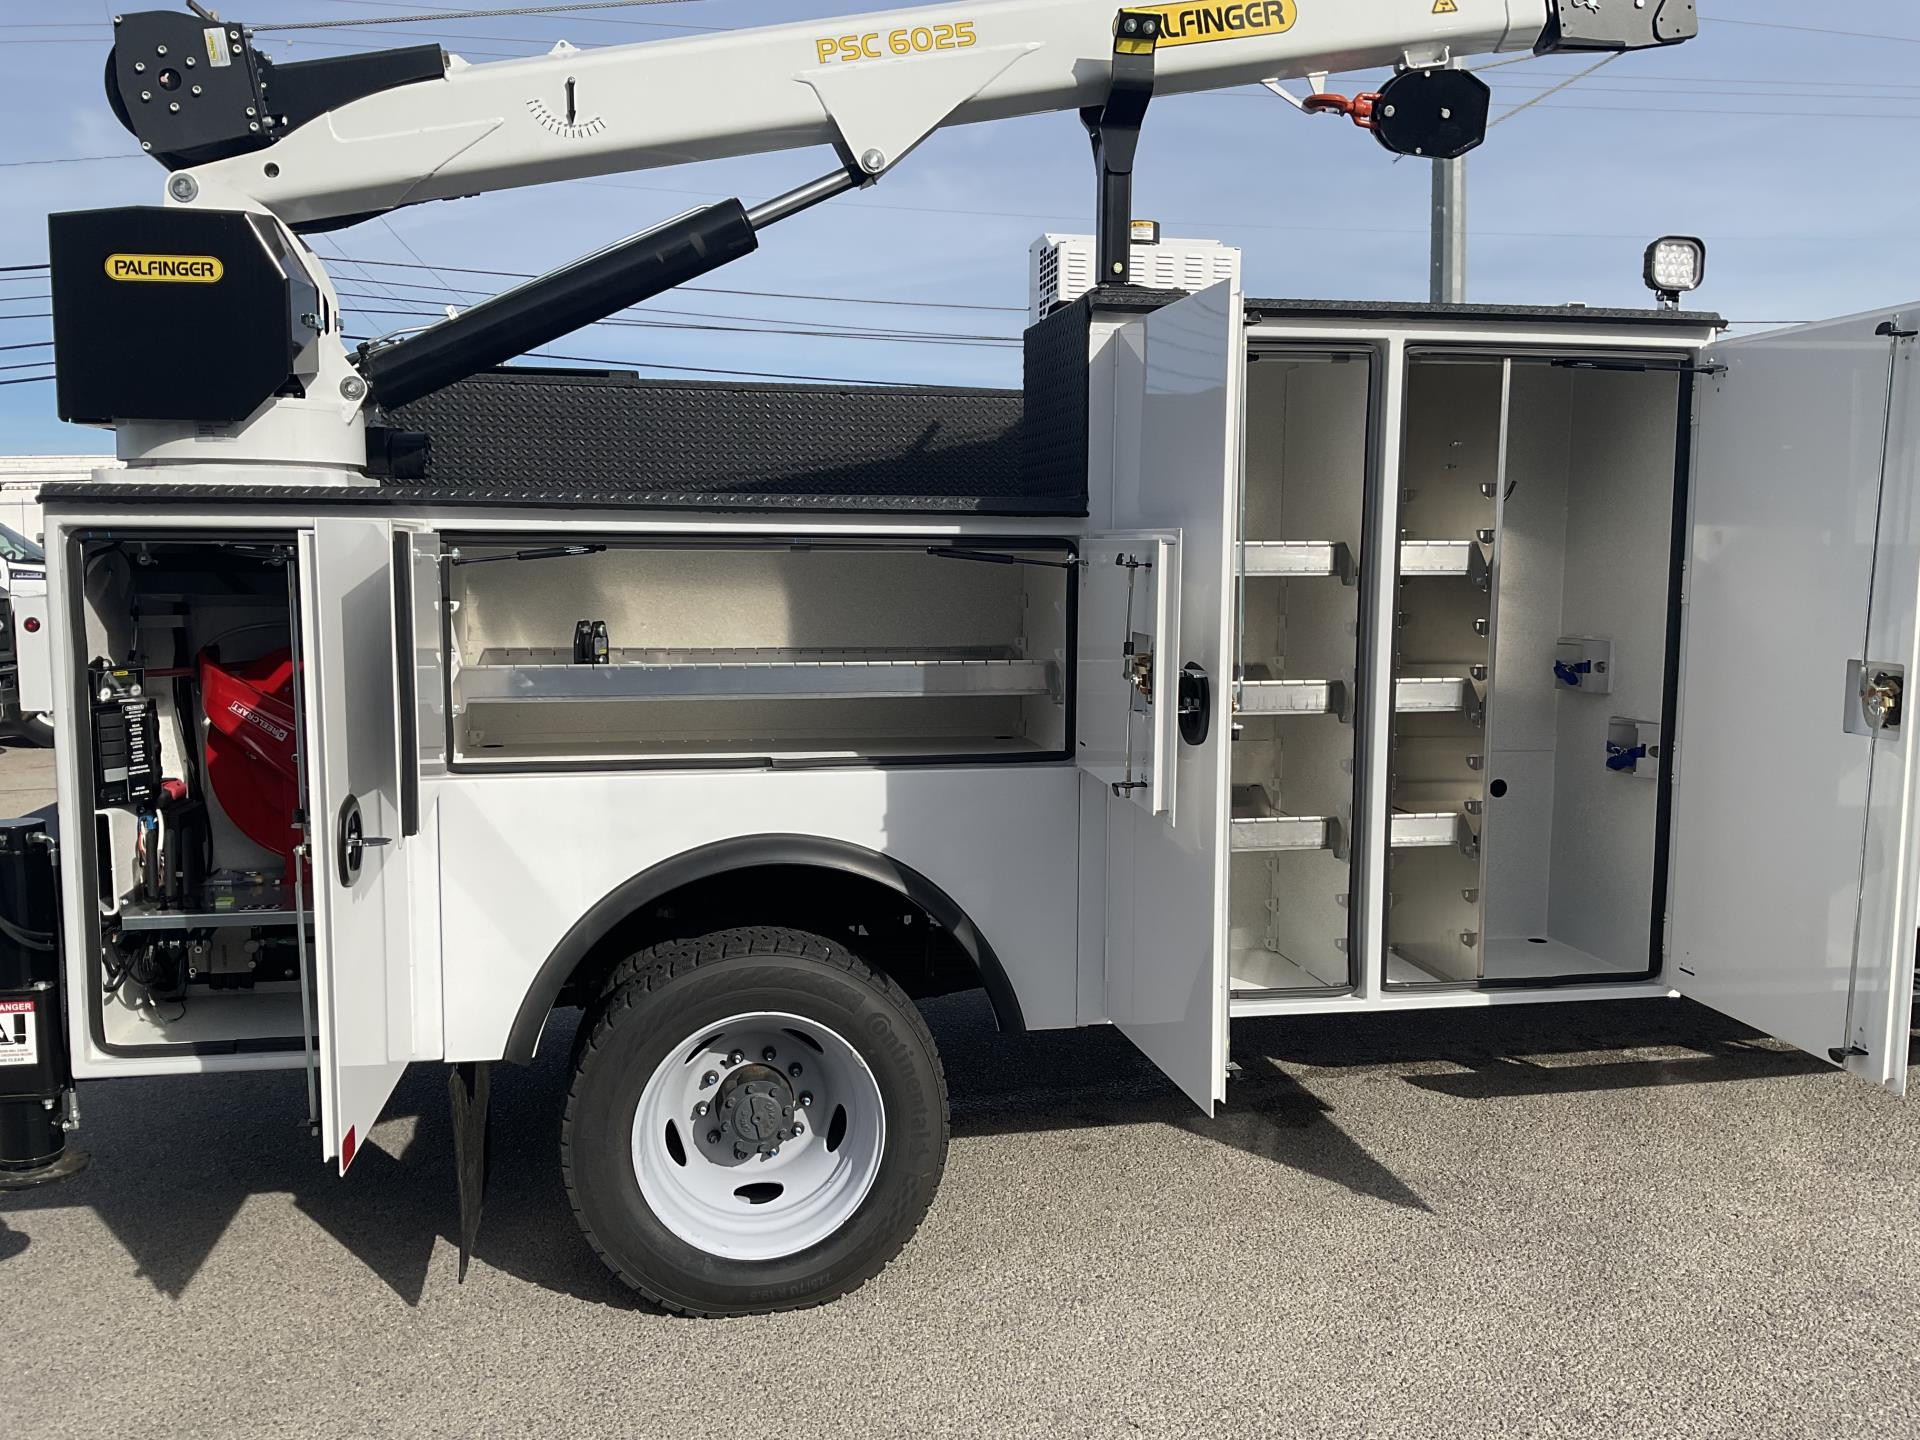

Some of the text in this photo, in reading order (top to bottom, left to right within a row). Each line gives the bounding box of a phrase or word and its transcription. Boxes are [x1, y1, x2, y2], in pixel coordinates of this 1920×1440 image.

[1159, 0, 1285, 39] LFINGER
[816, 21, 977, 64] PSC 6025
[114, 259, 214, 277] PALFINGER
[231, 703, 281, 738] REELCRAFT
[0, 1003, 31, 1011] ANGER
[864, 1012, 931, 1140] Continental
